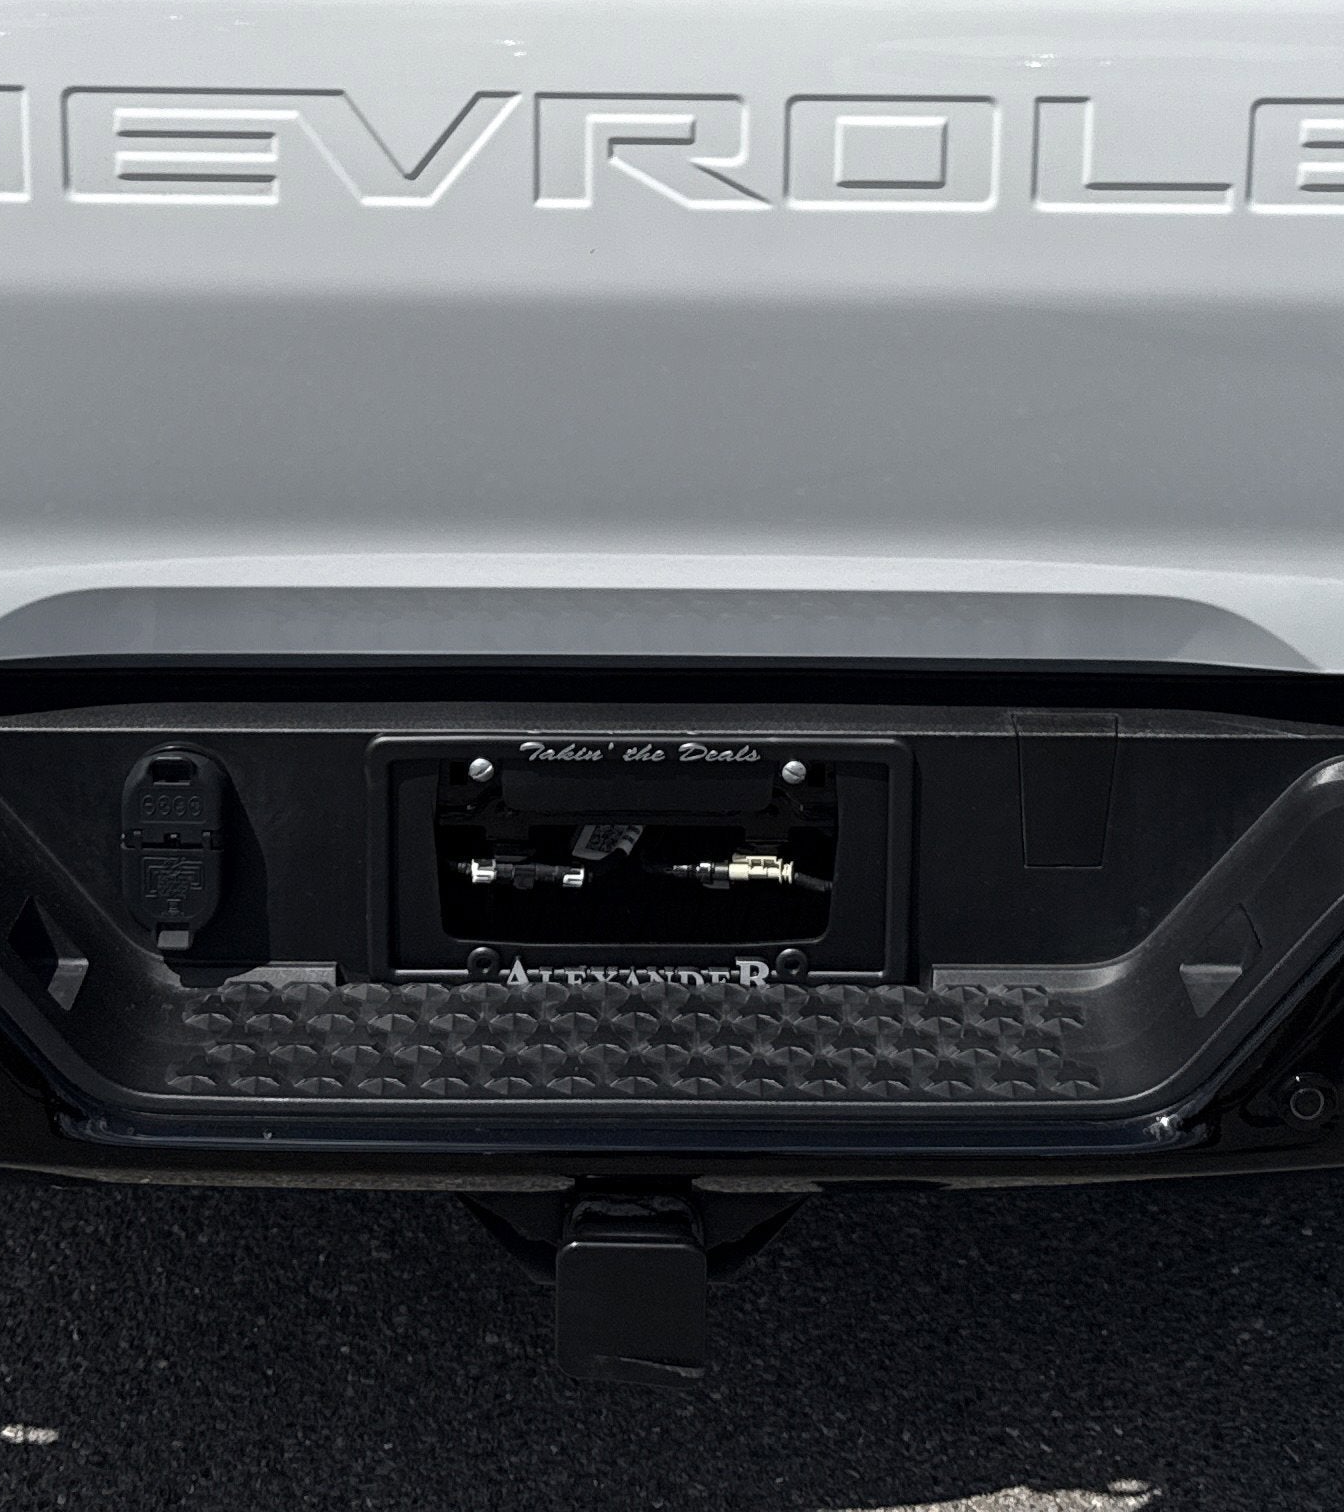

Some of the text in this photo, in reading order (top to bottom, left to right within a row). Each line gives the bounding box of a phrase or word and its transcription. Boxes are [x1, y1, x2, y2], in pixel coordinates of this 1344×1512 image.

[519, 741, 762, 762] Takin' the Deals
